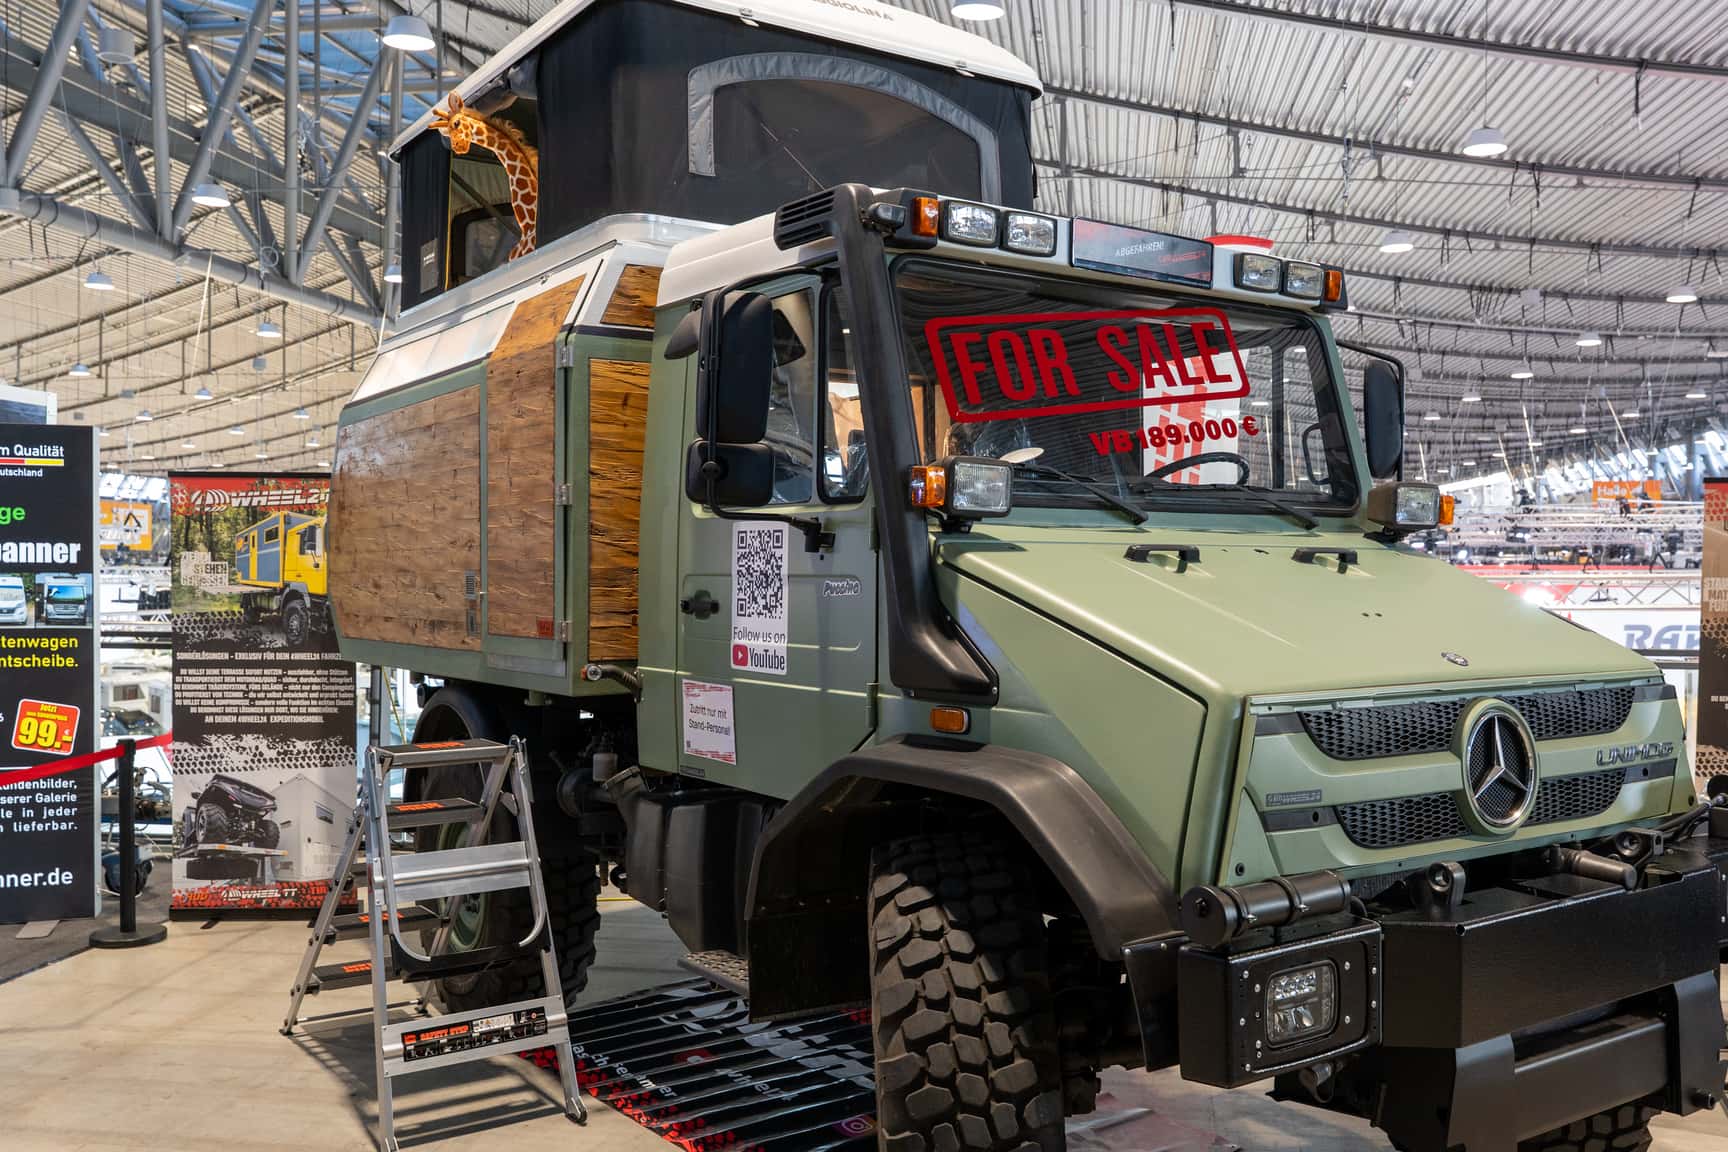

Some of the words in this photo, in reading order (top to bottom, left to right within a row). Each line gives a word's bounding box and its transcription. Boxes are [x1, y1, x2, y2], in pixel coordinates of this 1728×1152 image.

[949, 329, 1081, 405] FOR
[1096, 321, 1233, 393] SALE
[1089, 429, 1135, 456] VB
[1137, 417, 1238, 449] 189.000
[1241, 415, 1260, 436] €
[13, 444, 65, 458] Qualität
[0, 541, 81, 564] anner
[733, 626, 761, 641] Follow
[761, 630, 772, 643] us
[773, 632, 786, 645] on
[748, 648, 786, 671] YouTube
[689, 703, 707, 715] Zutritt
[707, 708, 717, 718] nur
[717, 709, 728, 720] mit
[1596, 741, 1675, 767] UNIMOG
[35, 792, 78, 804] Galerie
[22, 807, 34, 818] in
[43, 806, 78, 820] jeder
[13, 821, 78, 833] lieferbar.
